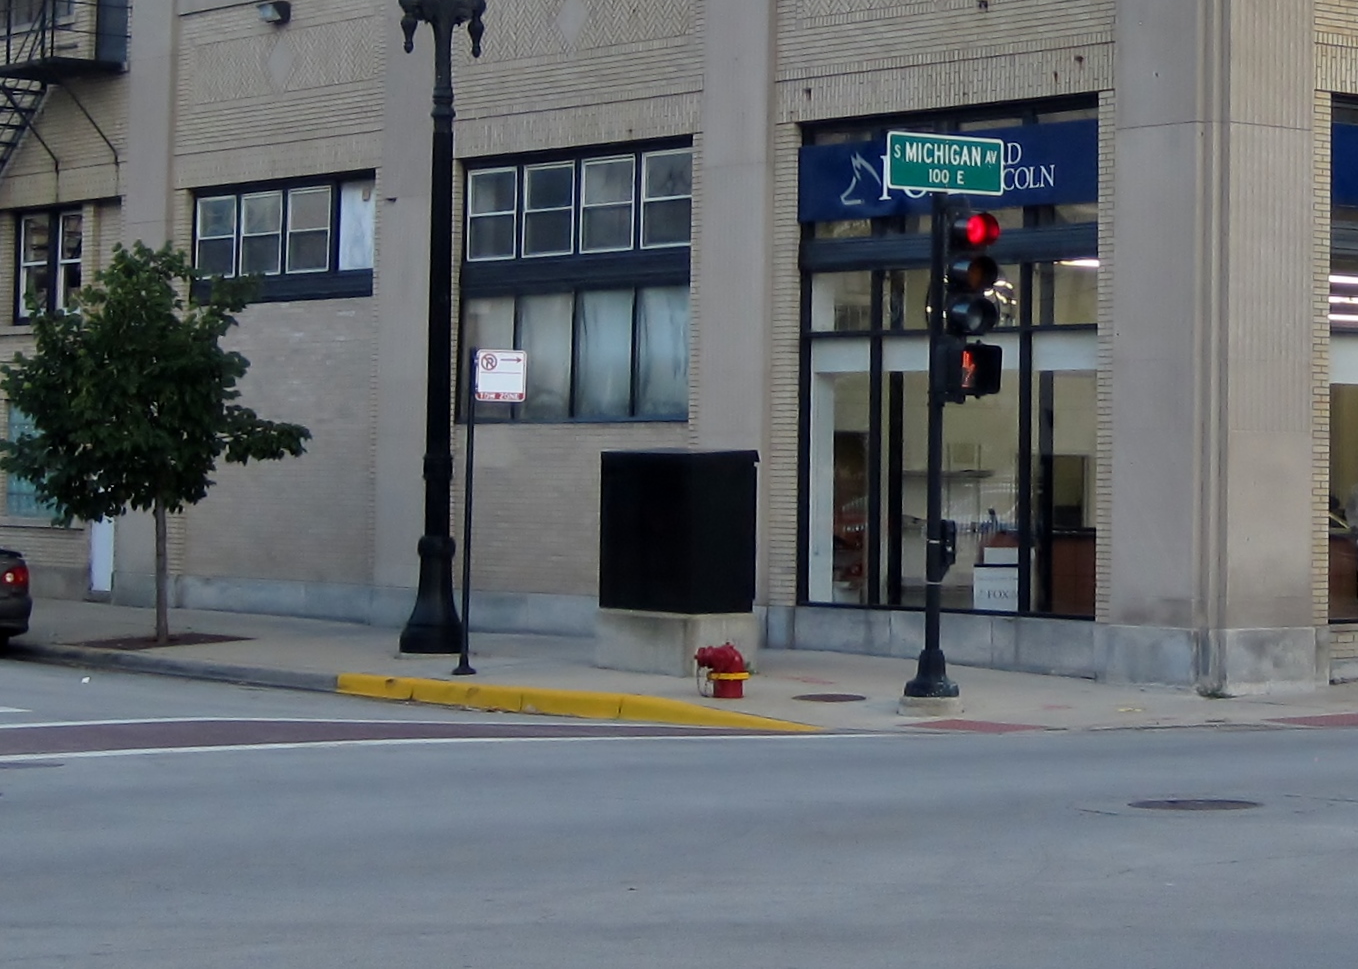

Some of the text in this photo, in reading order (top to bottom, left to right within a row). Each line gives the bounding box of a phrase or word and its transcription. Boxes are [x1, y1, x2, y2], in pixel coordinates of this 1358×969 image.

[893, 143, 901, 159] S
[905, 141, 981, 167] MICHIGAN
[985, 150, 998, 164] AV
[928, 168, 965, 185] 100 E
